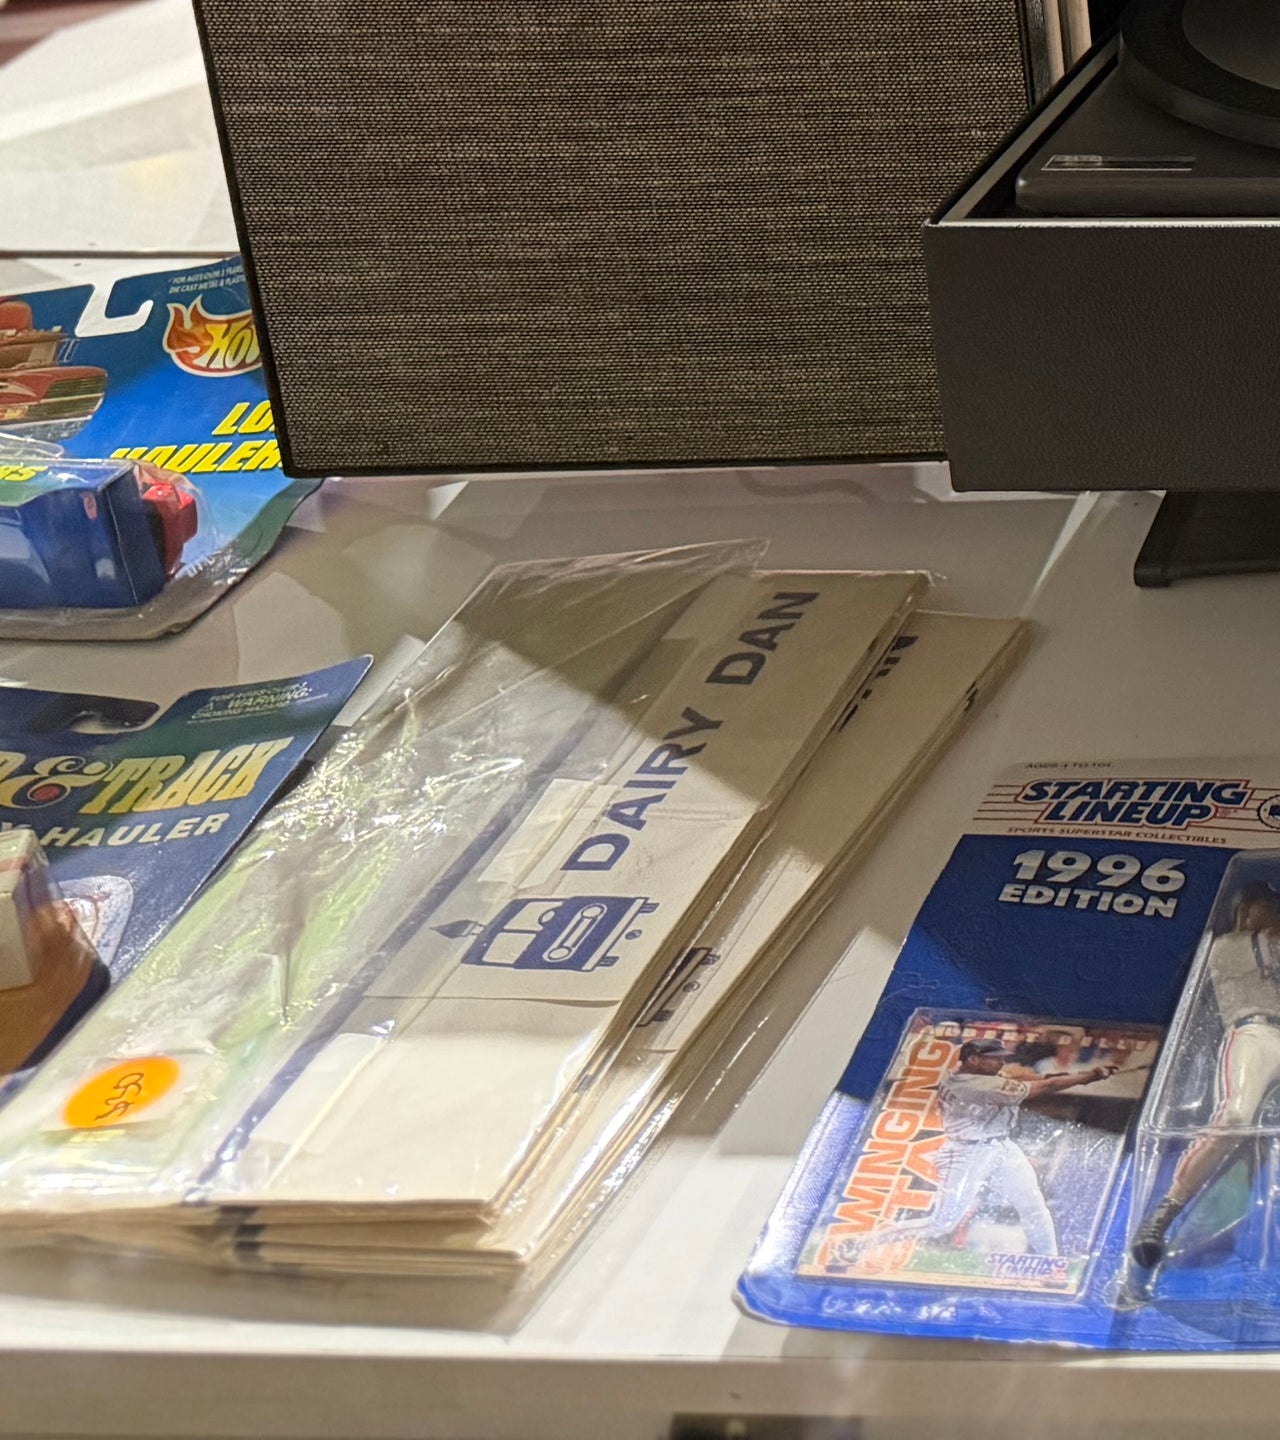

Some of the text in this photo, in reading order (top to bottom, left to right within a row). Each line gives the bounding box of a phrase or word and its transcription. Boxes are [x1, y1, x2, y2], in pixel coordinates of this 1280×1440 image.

[561, 591, 819, 872] DAIRY DAN
[79, 737, 294, 816] TRACK
[1021, 780, 1248, 806] STARTING
[41, 813, 230, 848] HAULER
[1043, 801, 1213, 827] LINEUP
[1059, 828, 1133, 839] SUPERSTAR
[1135, 833, 1227, 845] COLLECTIBLES
[1013, 849, 1187, 894] 1996
[998, 883, 1181, 919] EDITION
